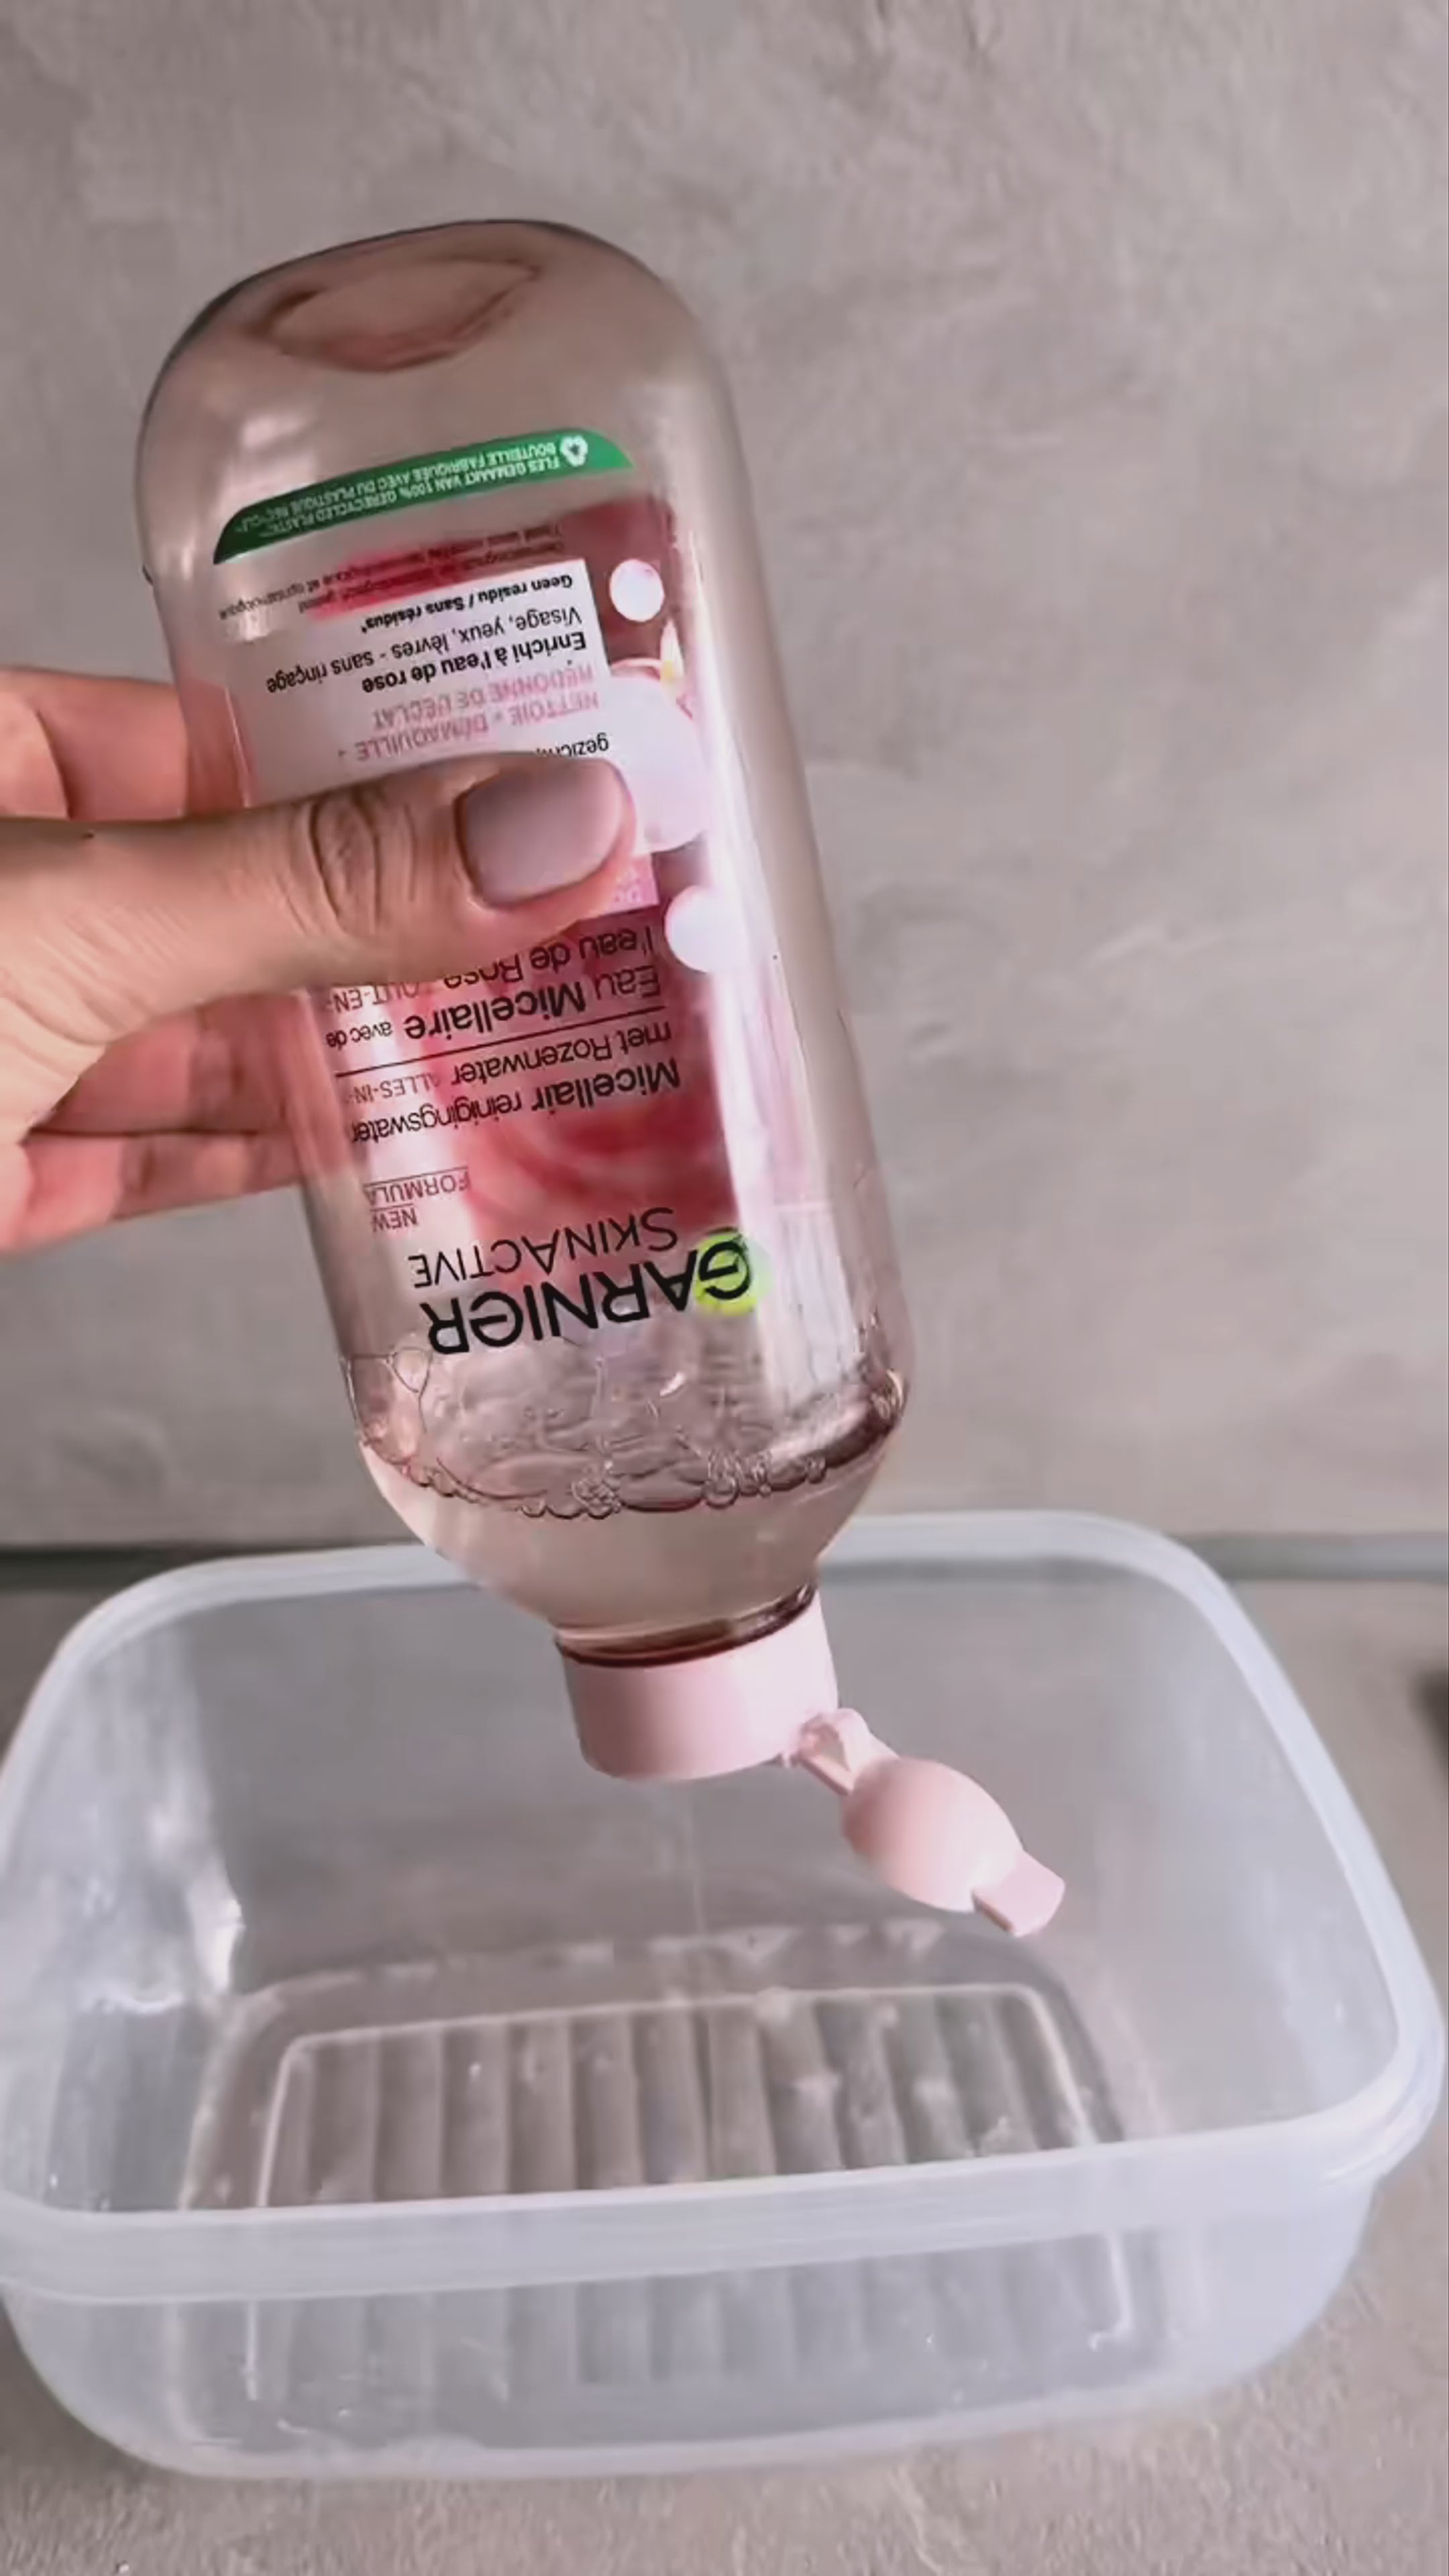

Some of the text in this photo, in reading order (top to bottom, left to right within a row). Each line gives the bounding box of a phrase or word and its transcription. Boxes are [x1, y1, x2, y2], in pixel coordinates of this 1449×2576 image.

[412, 451, 486, 482] FABRIQUÉE
[486, 442, 557, 466] BOUTEILLE
[527, 455, 560, 472] FLES
[377, 471, 411, 491] AVEC
[434, 475, 462, 492] VAN
[464, 462, 527, 486] GEMAAKT
[356, 480, 377, 495] DU
[477, 582, 528, 606] residu
[530, 574, 573, 594] Geen
[425, 596, 466, 616] Sans
[508, 606, 583, 632] Visage,
[451, 615, 506, 645] yeux,
[391, 634, 449, 660] lèvres
[330, 651, 375, 676] sans
[361, 630, 588, 694] Enrichi à l'eau de rose
[266, 663, 328, 694] rinçage
[457, 688, 486, 709] DE
[578, 925, 655, 960] l'eau
[529, 943, 571, 975] de
[325, 964, 661, 1051] Eau Micellaire avec de
[616, 1021, 672, 1055] met
[450, 1035, 613, 1087] Rozenwater
[351, 1057, 681, 1144] Micellair reinigingswater
[363, 1171, 471, 1206] FORMULA
[371, 1207, 418, 1232] NEW
